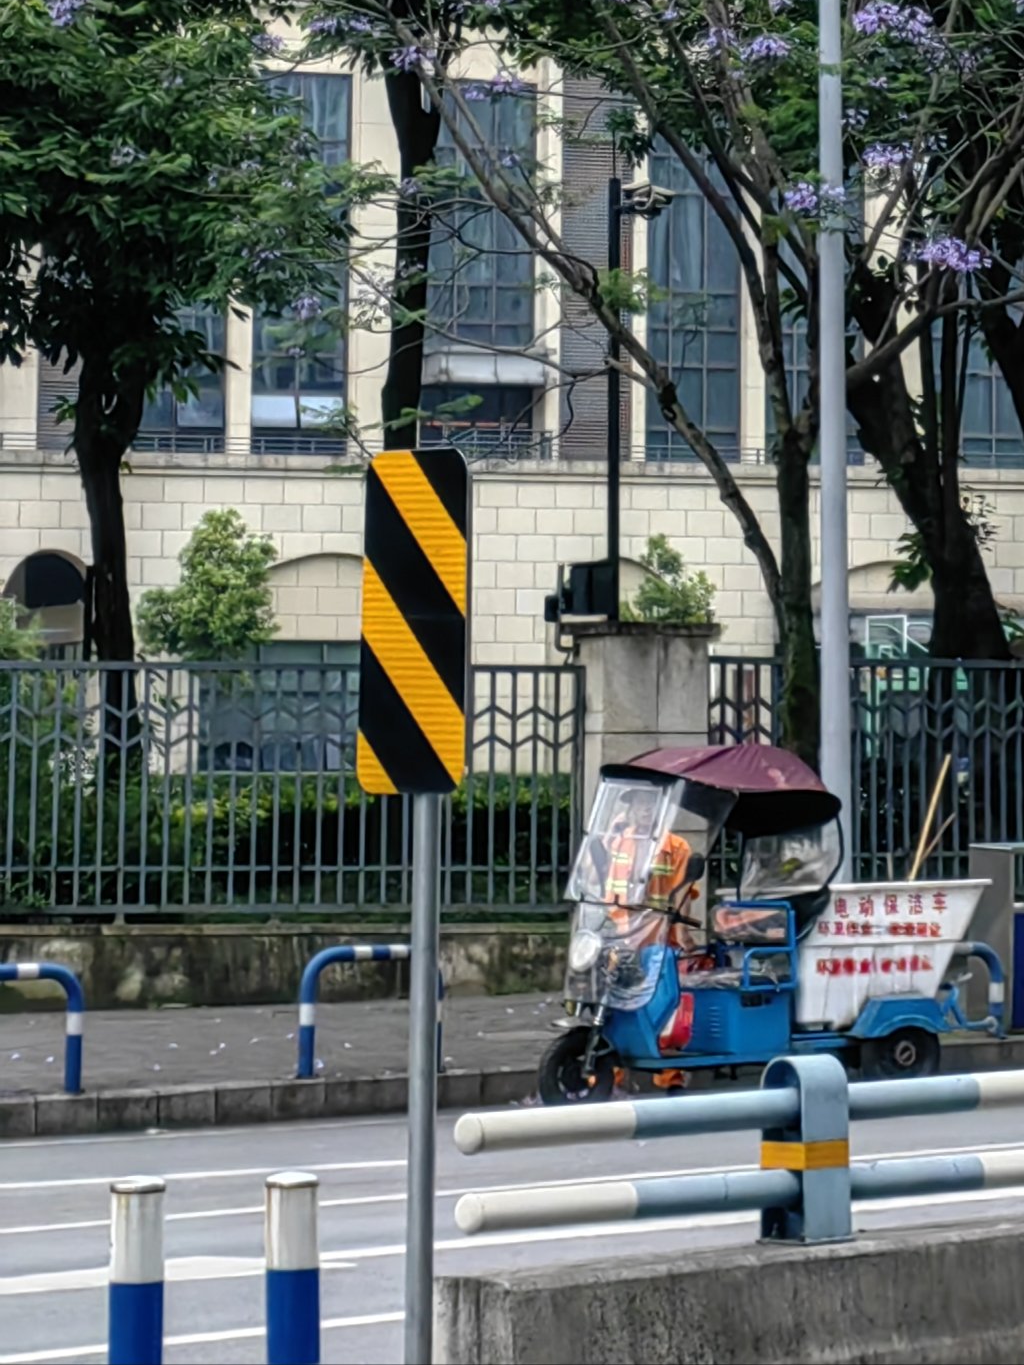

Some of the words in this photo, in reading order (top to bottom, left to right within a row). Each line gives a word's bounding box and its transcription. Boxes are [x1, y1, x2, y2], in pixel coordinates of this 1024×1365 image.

[834, 891, 948, 918] 电动保洁车
